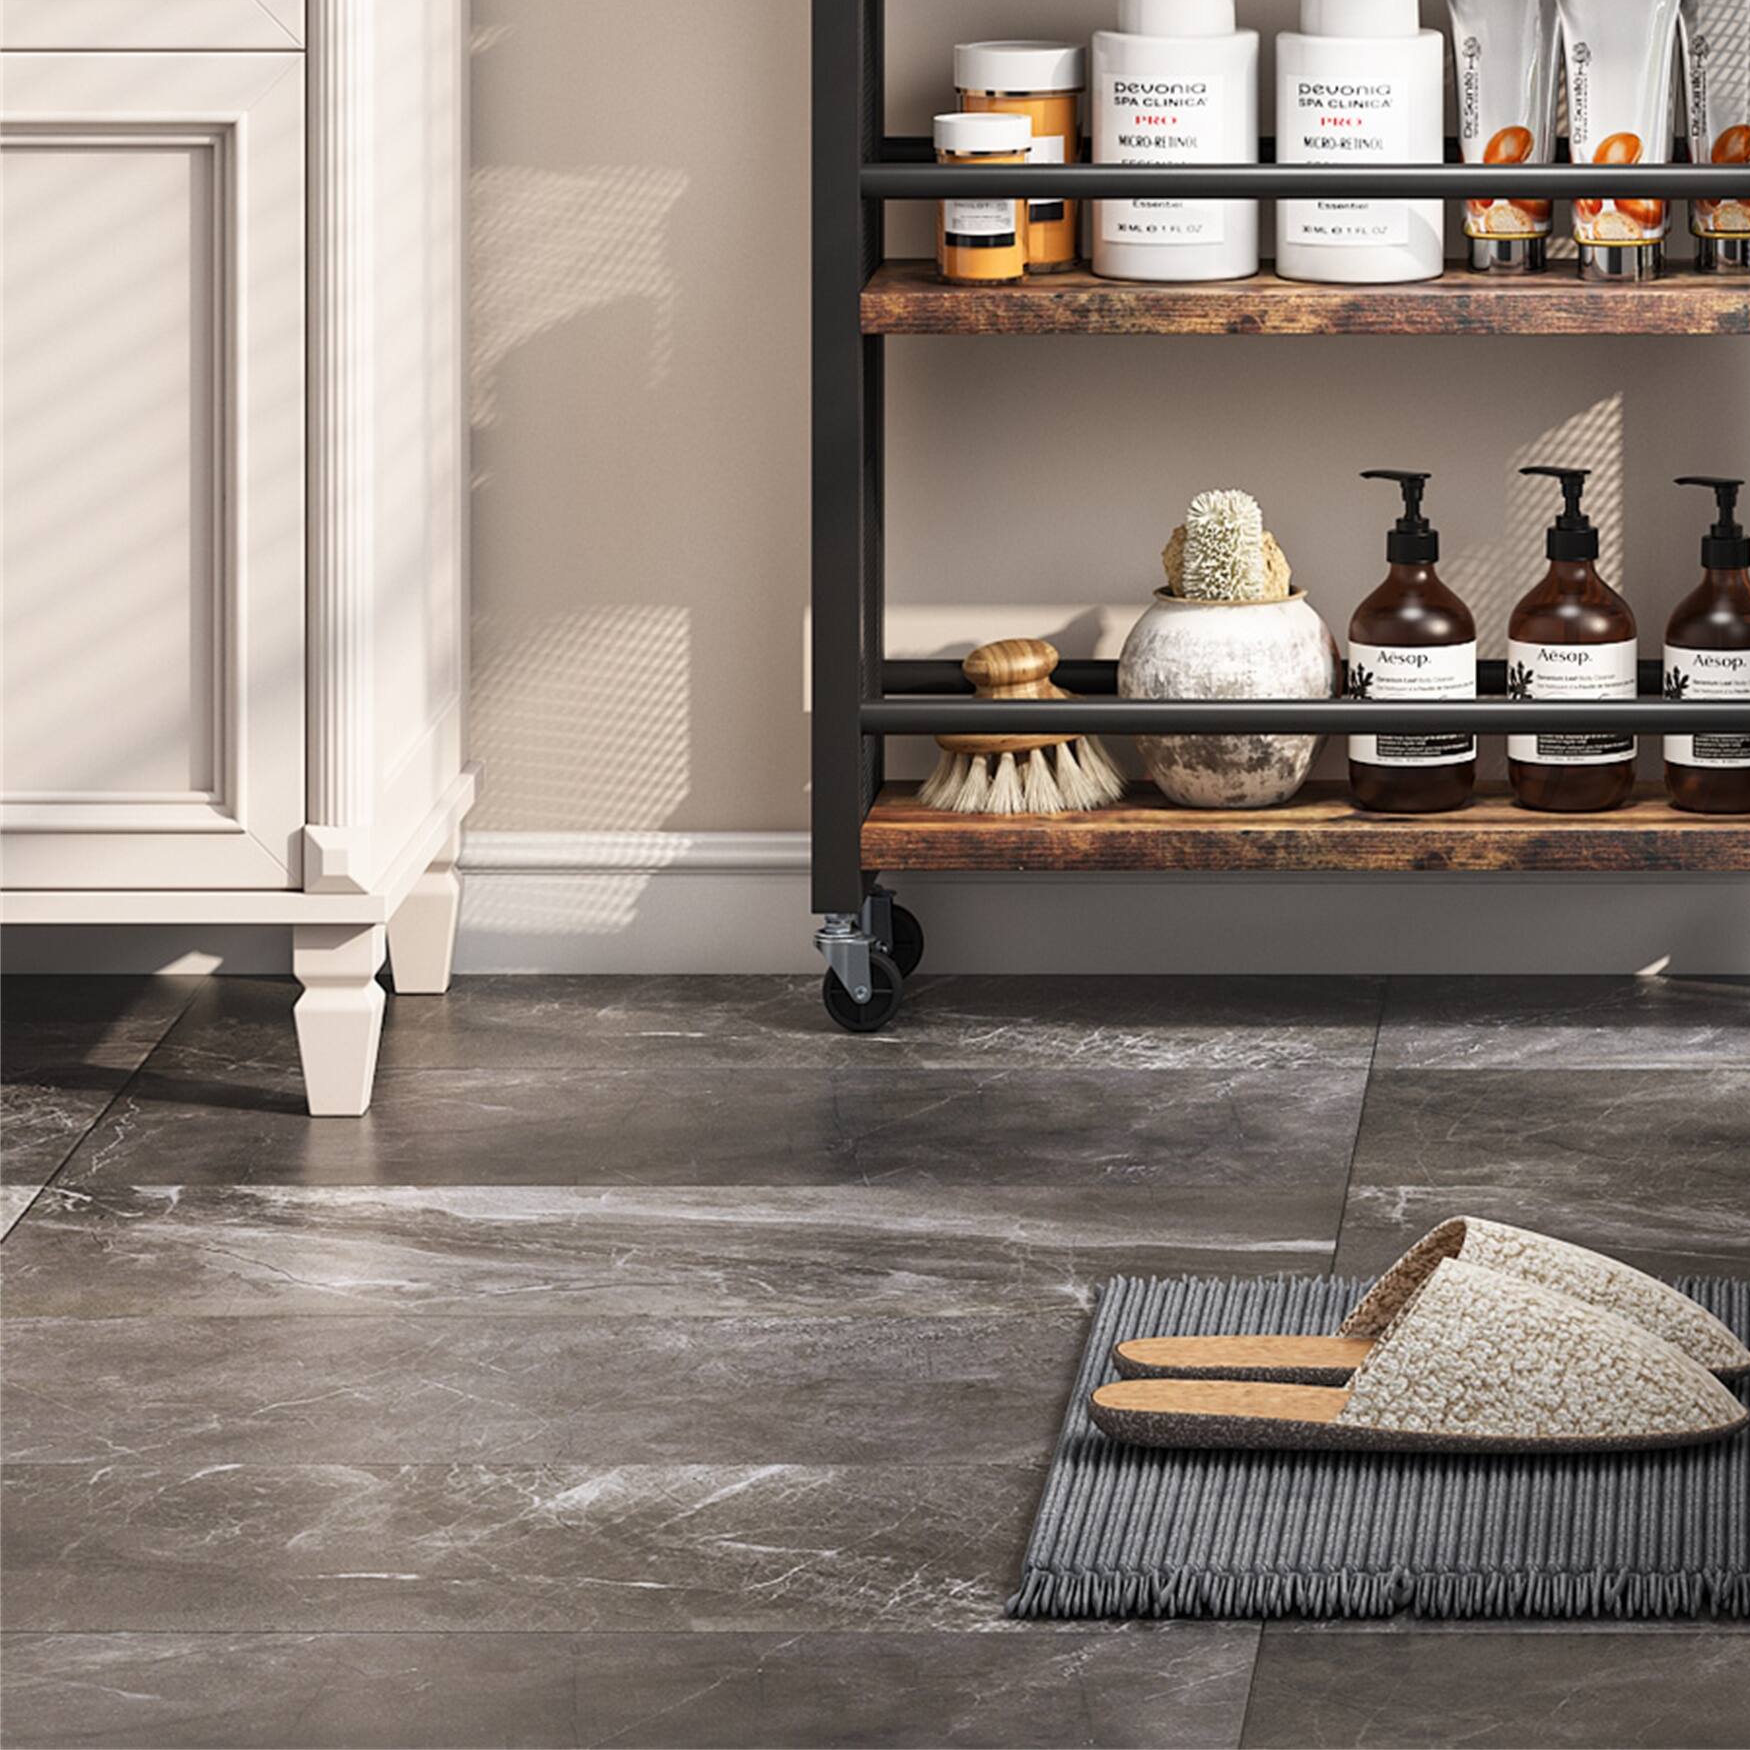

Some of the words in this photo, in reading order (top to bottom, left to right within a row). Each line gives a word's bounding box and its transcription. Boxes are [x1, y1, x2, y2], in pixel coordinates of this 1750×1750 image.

[1114, 96, 1138, 106] SPA
[1299, 98, 1323, 108] SPA
[1135, 115, 1177, 125] PRO
[1321, 117, 1362, 126] PRO
